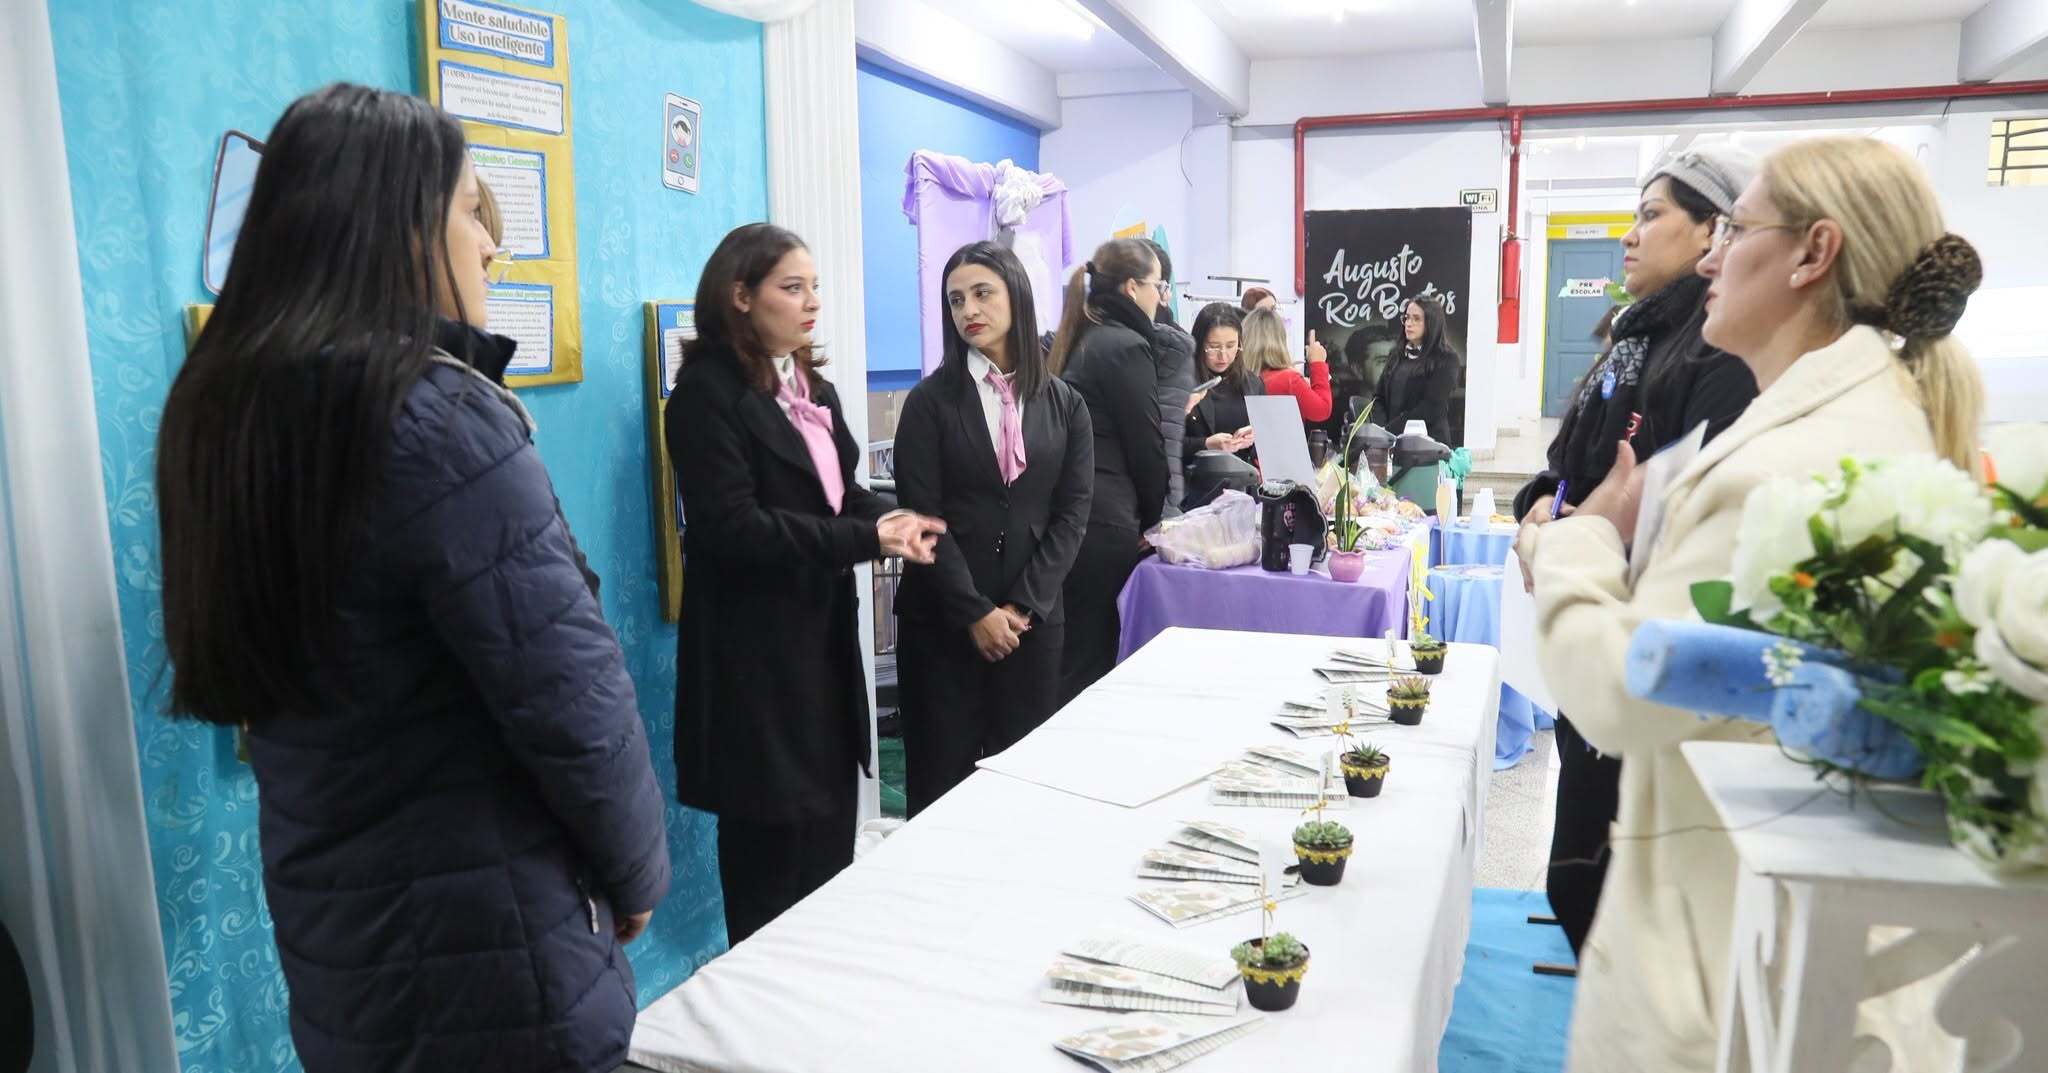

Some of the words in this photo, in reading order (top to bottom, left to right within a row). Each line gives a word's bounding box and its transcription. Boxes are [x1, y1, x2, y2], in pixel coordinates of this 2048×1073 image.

[443, 2, 485, 25] Mente
[488, 14, 548, 38] saludable
[449, 23, 476, 43] Uso
[479, 31, 544, 55] inteligente
[507, 155, 541, 168] General
[1323, 244, 1423, 299] Augusto
[1318, 292, 1371, 327] Roa
[1371, 282, 1456, 320] Btos
